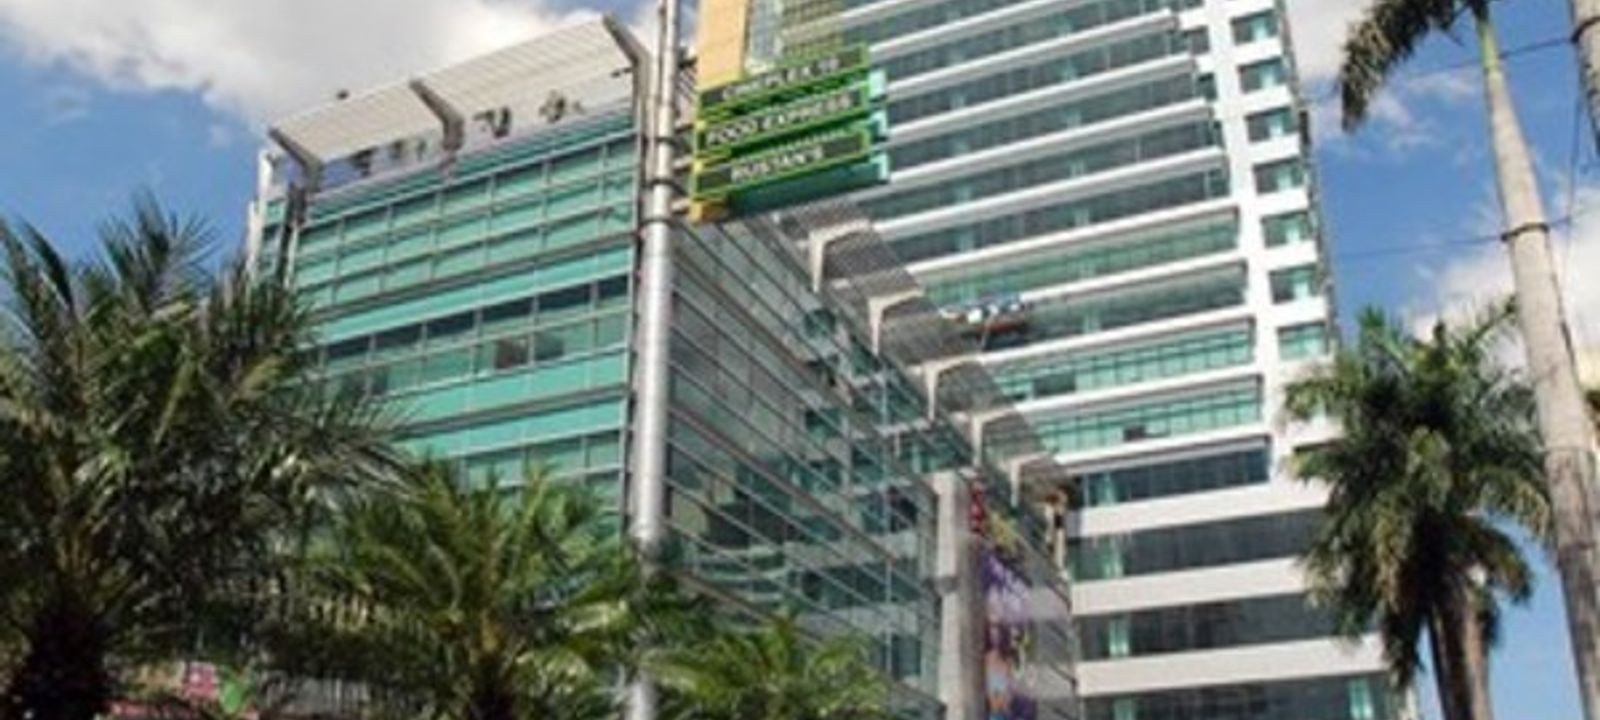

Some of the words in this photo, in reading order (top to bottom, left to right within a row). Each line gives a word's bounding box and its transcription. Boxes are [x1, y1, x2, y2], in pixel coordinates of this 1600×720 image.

[706, 118, 758, 146] FOOD
[762, 95, 853, 131] EXPRESS
[731, 145, 824, 183] RUSTAN'S
